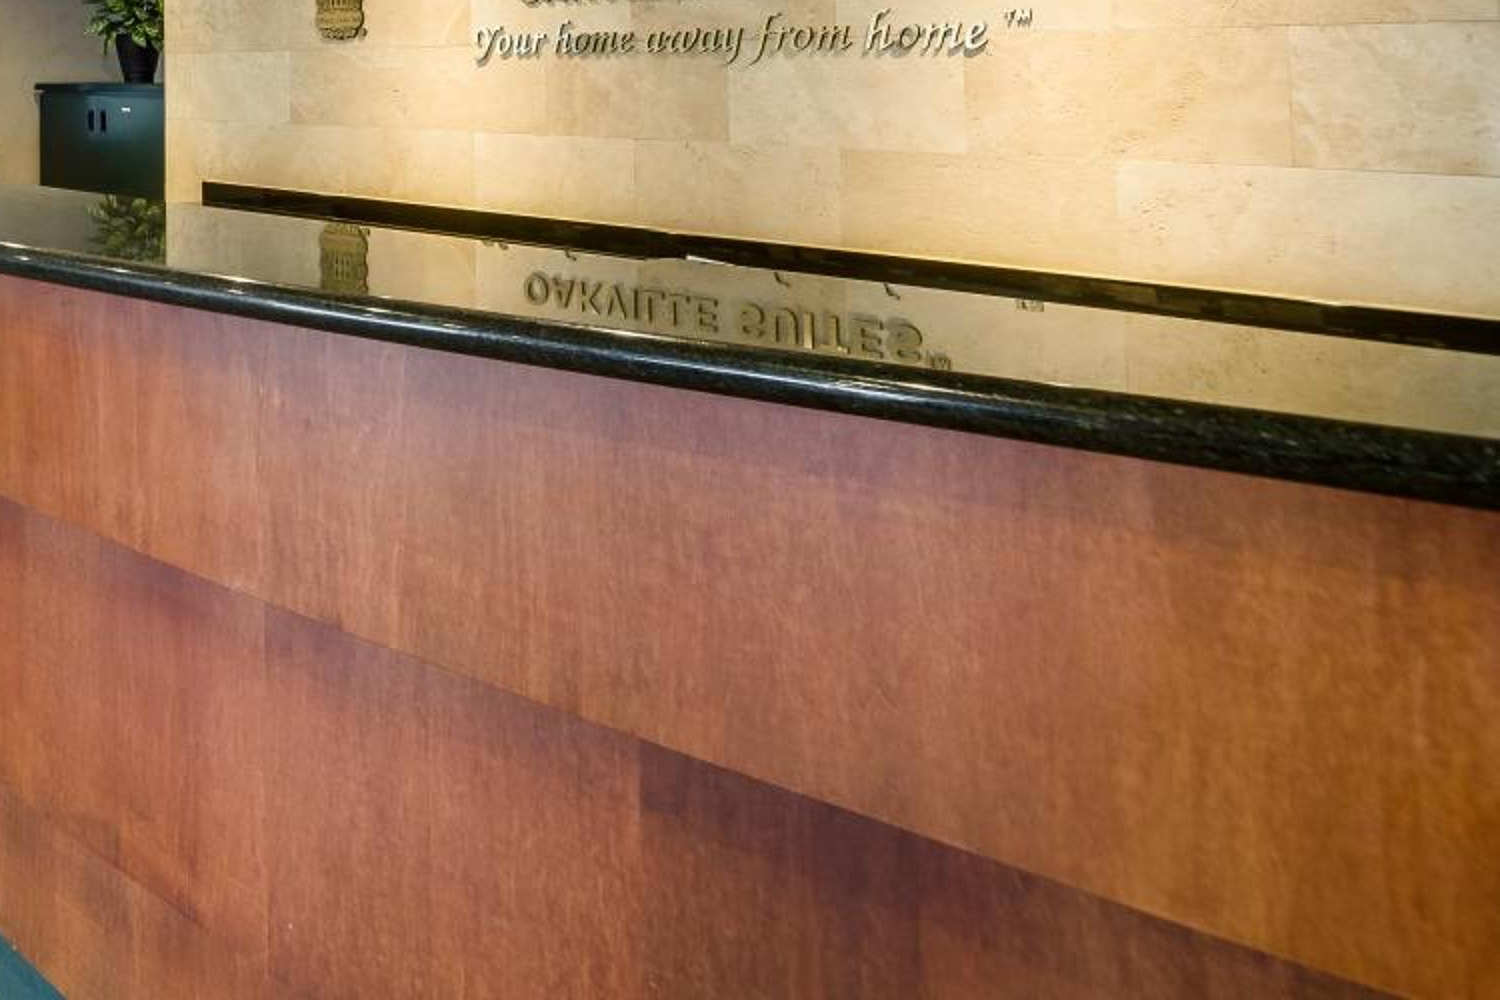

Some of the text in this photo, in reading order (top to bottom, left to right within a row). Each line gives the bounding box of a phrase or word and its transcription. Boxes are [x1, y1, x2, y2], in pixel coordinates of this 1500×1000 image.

[476, 24, 547, 67] Your
[555, 20, 636, 57] home
[645, 27, 746, 66] away
[739, 9, 854, 66] from
[862, 7, 989, 58] home
